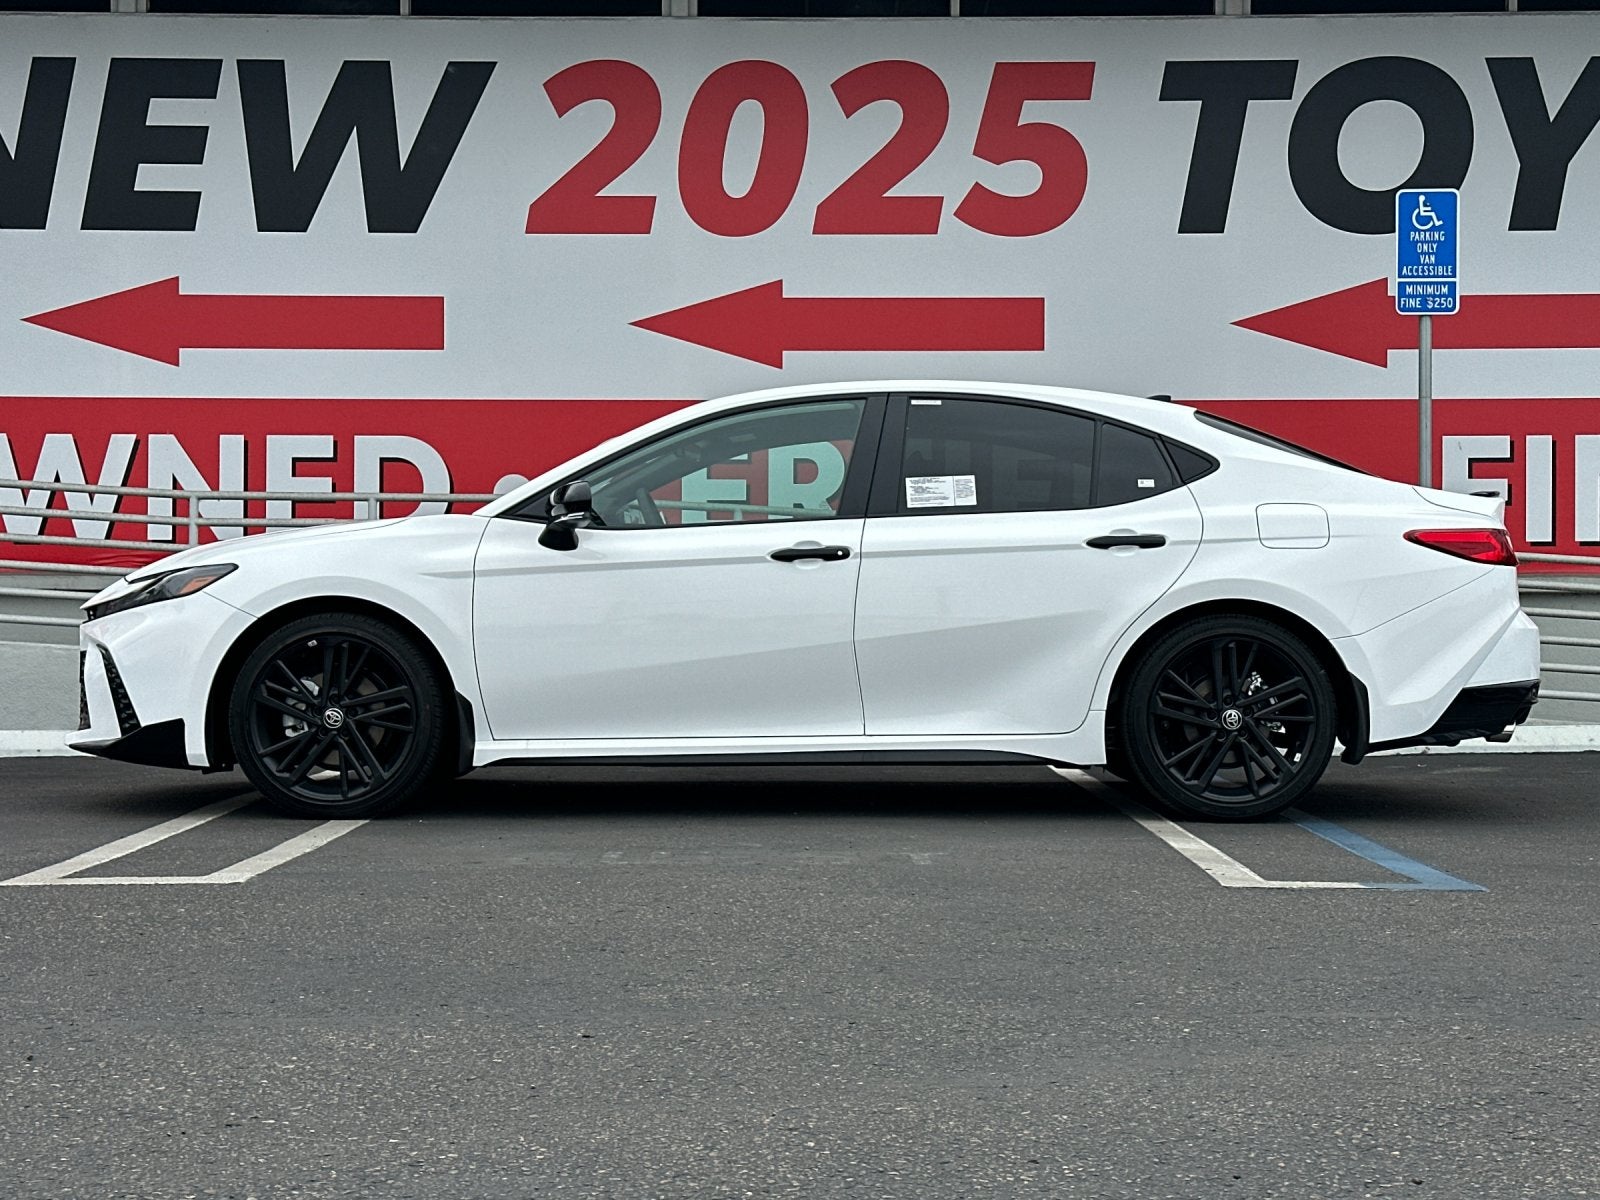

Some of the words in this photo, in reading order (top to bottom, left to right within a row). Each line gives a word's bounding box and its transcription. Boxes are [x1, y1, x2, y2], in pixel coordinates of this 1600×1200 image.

[525, 59, 1095, 237] 2025
[1159, 56, 1600, 235] TOY
[1410, 231, 1445, 241] PARKING
[1416, 243, 1438, 253] ONLY
[1419, 254, 1435, 265] VAN
[1402, 265, 1453, 276] ACCESSIBLE
[1405, 284, 1449, 295] MINIMUM
[1400, 297, 1422, 308] FINE
[1426, 296, 1453, 309] $250
